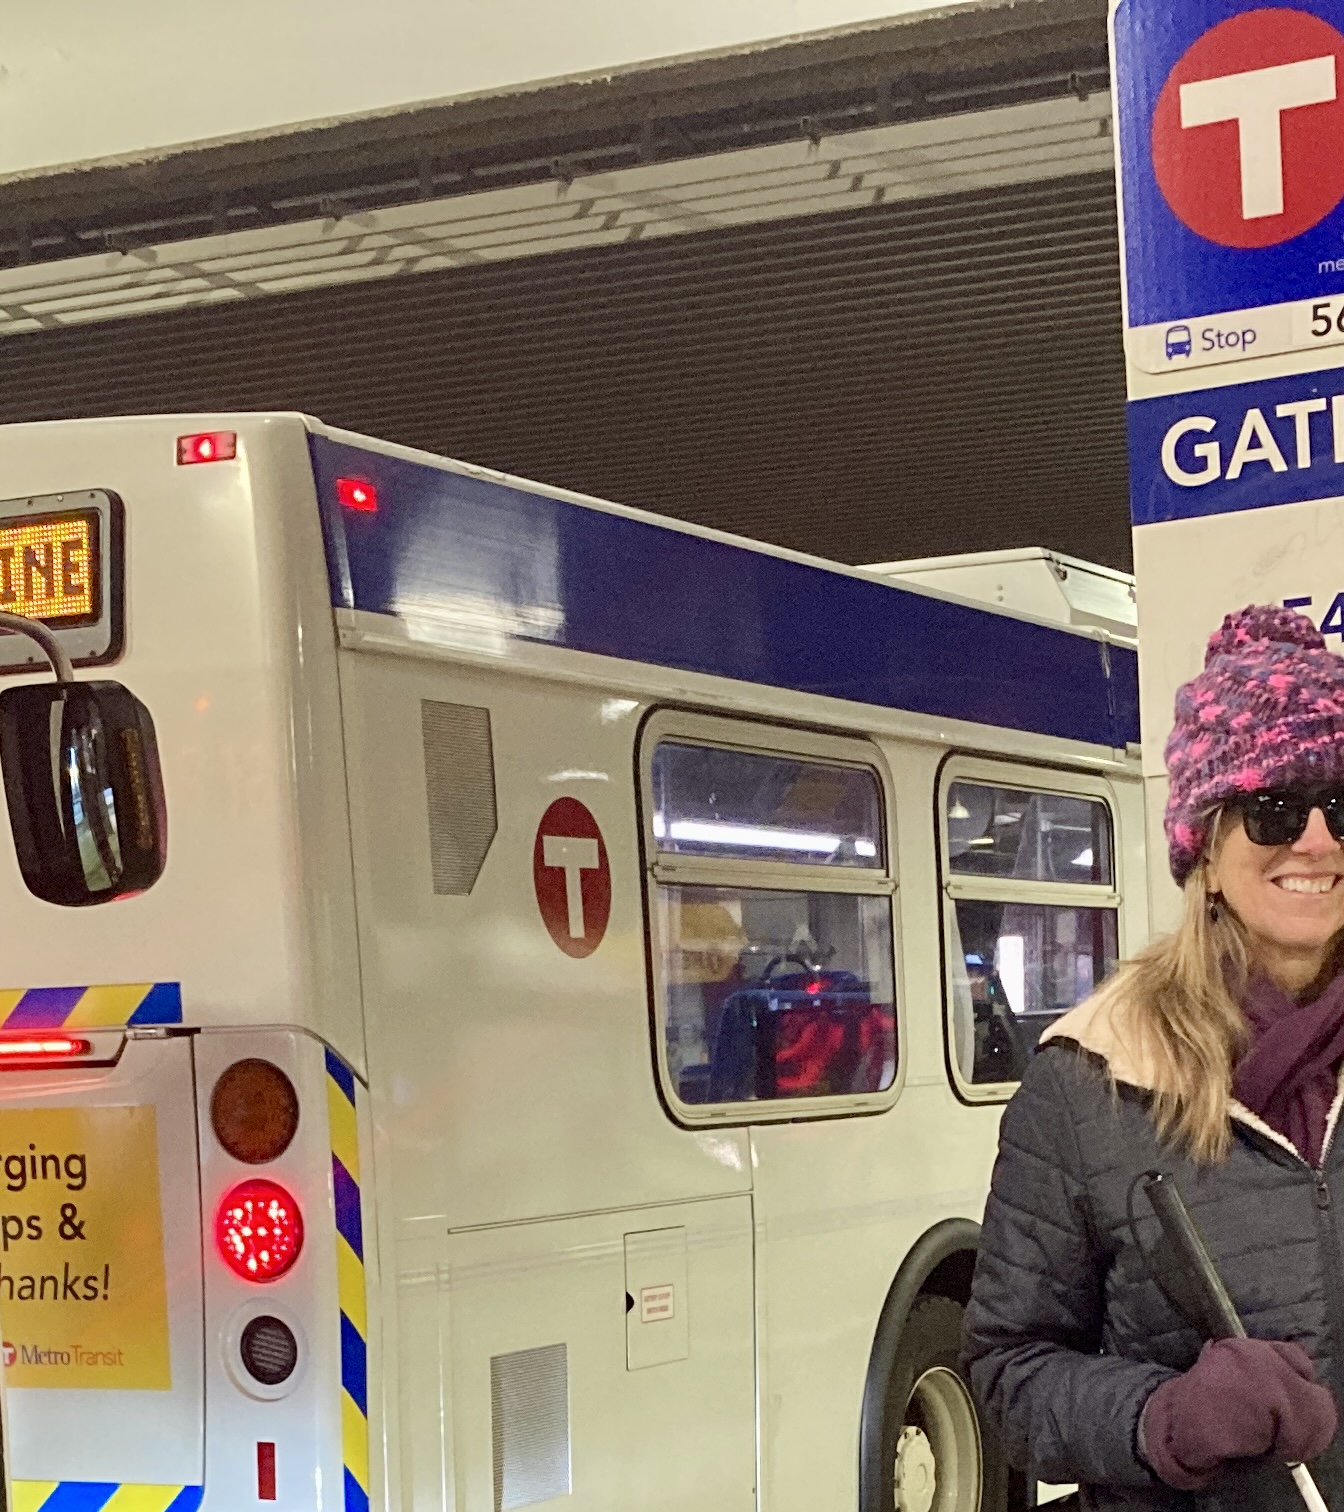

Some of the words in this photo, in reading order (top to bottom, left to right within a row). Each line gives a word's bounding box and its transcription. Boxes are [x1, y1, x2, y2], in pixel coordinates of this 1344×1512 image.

[1179, 54, 1337, 221] T
[1200, 324, 1258, 352] Stop
[542, 836, 600, 940] T
[58, 1202, 87, 1241] &
